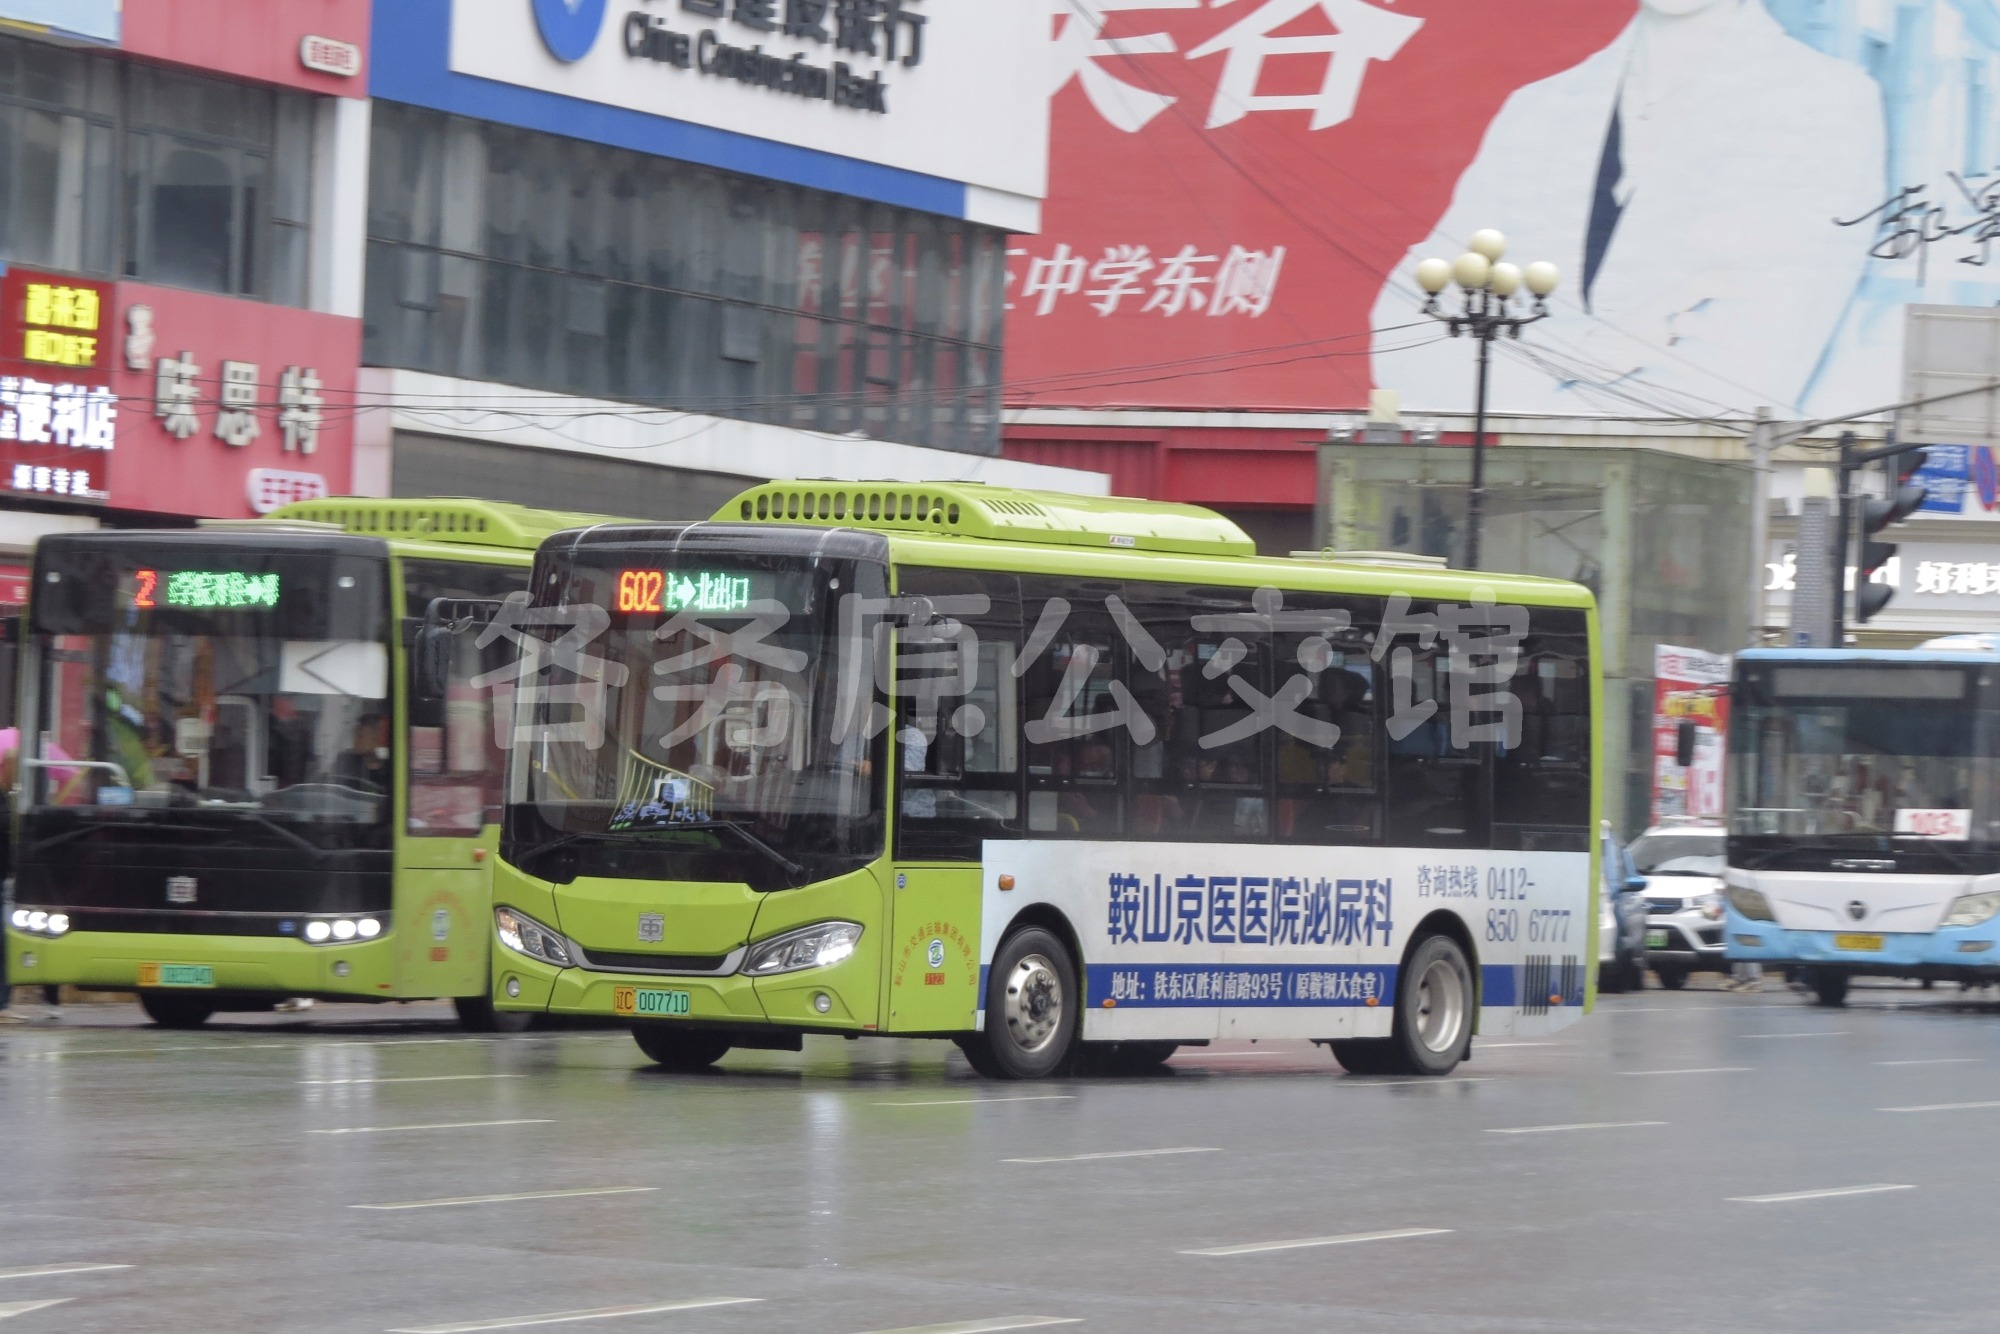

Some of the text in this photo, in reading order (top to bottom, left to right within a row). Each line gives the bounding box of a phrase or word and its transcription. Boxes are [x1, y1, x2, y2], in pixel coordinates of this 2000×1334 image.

[642, 0, 927, 67] 建设银行
[625, 11, 690, 69] China
[833, 61, 890, 115] Bank
[155, 350, 324, 454] 味思特
[134, 570, 157, 606] 2
[619, 571, 663, 611] 602
[1417, 864, 1535, 900] 咨询热线 0412-
[1107, 872, 1393, 946] 鞍山京医医院泌尿科
[1485, 907, 1571, 942] 850 6777
